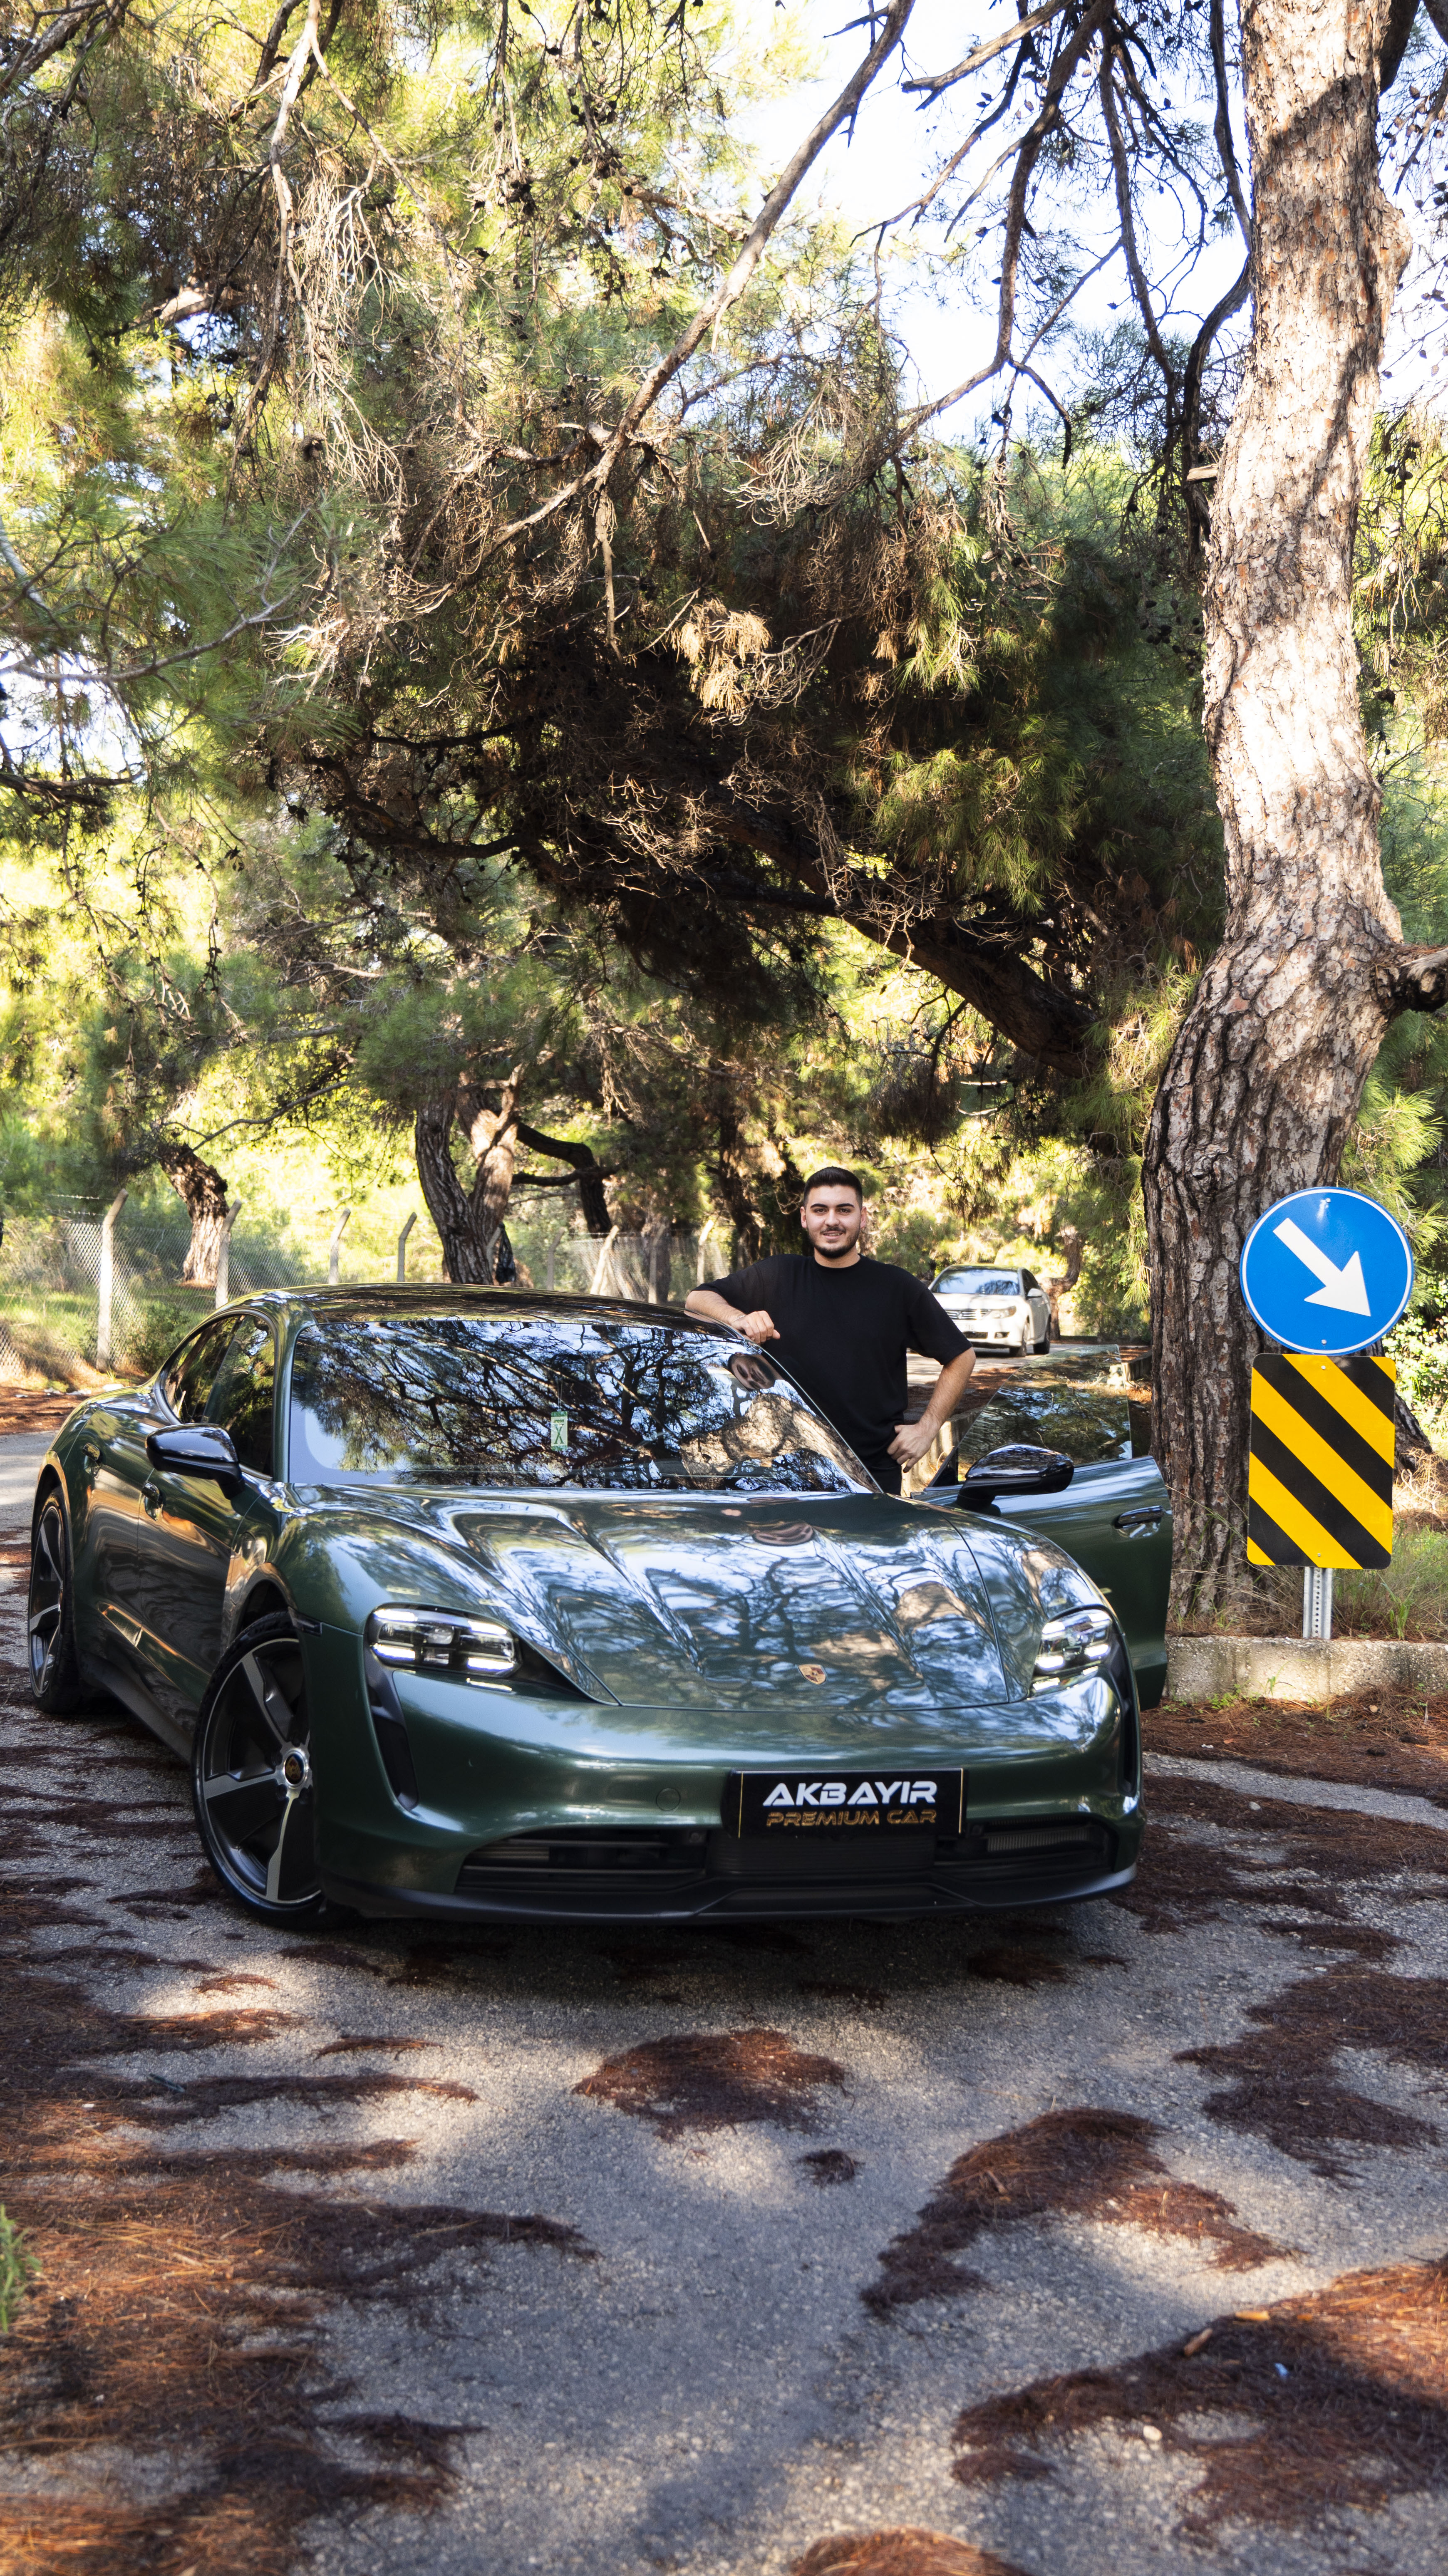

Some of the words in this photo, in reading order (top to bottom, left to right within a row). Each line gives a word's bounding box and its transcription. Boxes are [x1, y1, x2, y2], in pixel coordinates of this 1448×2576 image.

[554, 1424, 564, 1444] X
[763, 1781, 937, 1806] AKBAYIR
[766, 1810, 879, 1827] PREMIUM
[887, 1810, 937, 1824] CAR
